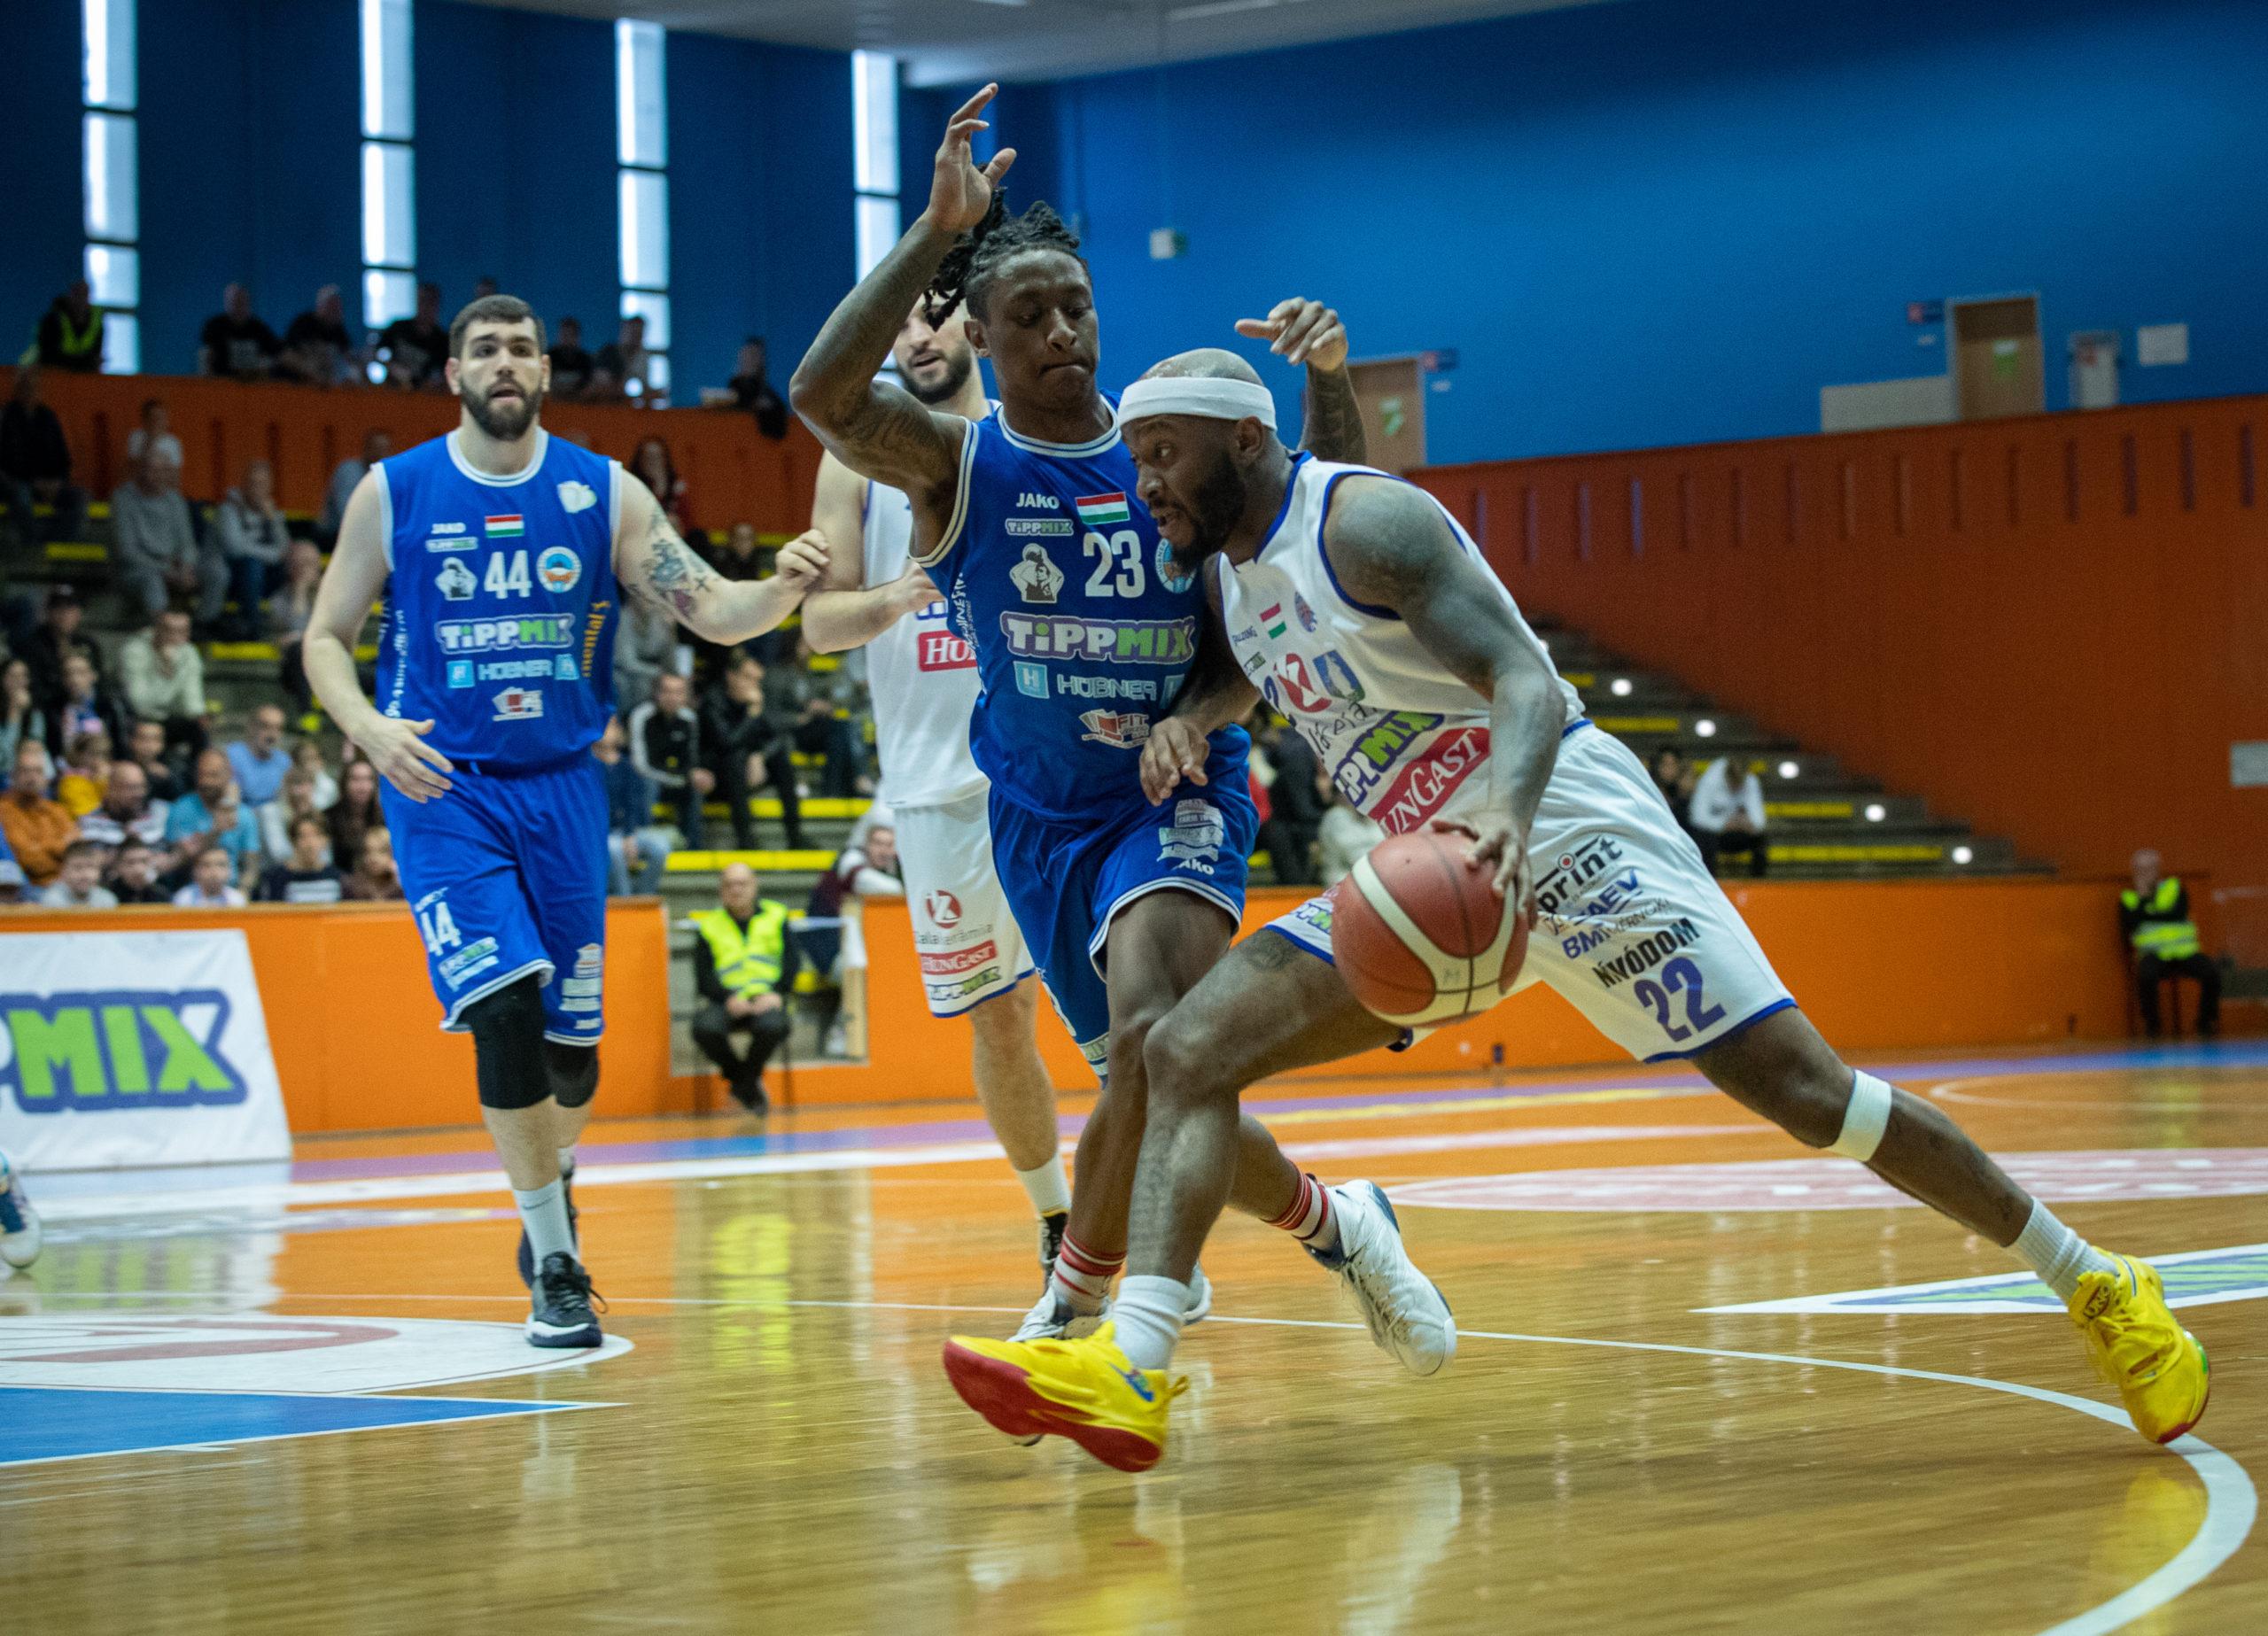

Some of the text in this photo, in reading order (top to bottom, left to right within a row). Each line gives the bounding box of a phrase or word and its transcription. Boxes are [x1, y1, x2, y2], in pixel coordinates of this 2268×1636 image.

[1015, 492, 1060, 509] JAKO
[484, 549, 532, 599] 44
[1083, 530, 1146, 598] 23
[1634, 957, 1727, 1043] 22
[0, 1002, 235, 1098] MIX
